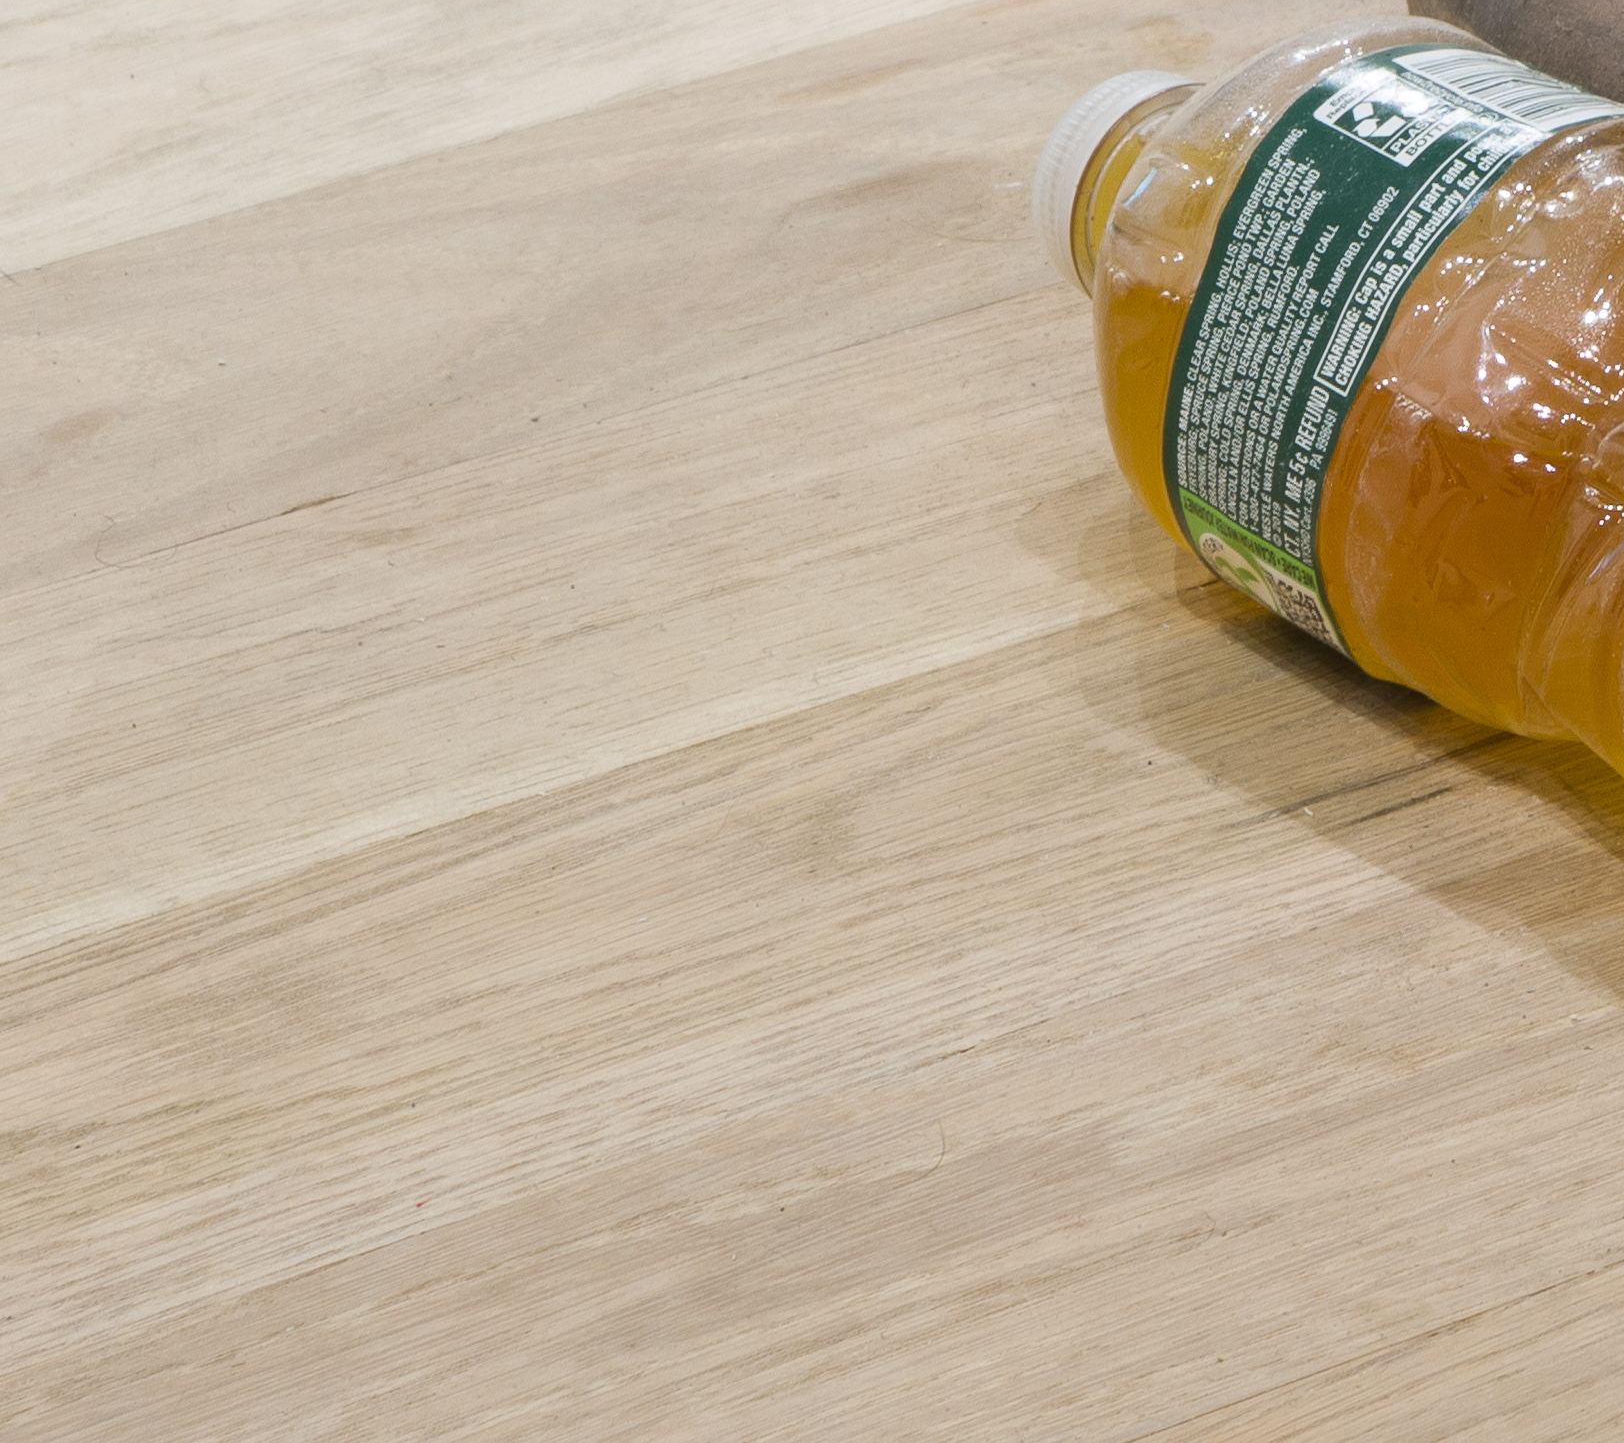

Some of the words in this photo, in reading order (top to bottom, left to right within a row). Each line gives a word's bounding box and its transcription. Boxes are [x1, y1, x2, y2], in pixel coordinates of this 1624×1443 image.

[1292, 185, 1325, 235] SPRING,
[1368, 183, 1399, 222] 06902
[1276, 233, 1298, 268] LUNA
[1315, 220, 1339, 254] CALL
[1357, 218, 1375, 239] CT
[1178, 383, 1194, 431] MAINE:
[1187, 339, 1206, 381] CLEAR
[1198, 289, 1224, 338] SPRING,
[1233, 167, 1274, 239] EVERGREEN
[1268, 123, 1305, 169] SPRING,
[1190, 374, 1208, 425] SPRUCE
[1200, 324, 1225, 374] SPRING,
[1217, 277, 1239, 323] PIERCE
[1232, 241, 1251, 277] POND
[1262, 156, 1295, 207] GARDEN
[1261, 268, 1283, 309] BELLA
[1291, 250, 1321, 302] REPORT
[1320, 238, 1363, 307] STAMFORD,
[1321, 304, 1362, 378] WARNING:
[1353, 275, 1379, 305] Cap
[1369, 259, 1387, 275] is
[1382, 247, 1396, 260] a
[1390, 208, 1423, 248] small
[1417, 179, 1443, 214] part
[1440, 157, 1466, 185] and
[1334, 320, 1372, 386] CHOKING
[1363, 260, 1408, 320] HAZARD,
[1400, 188, 1464, 265] particularly
[1456, 169, 1480, 191] for
[1207, 352, 1227, 393] WHITE
[1220, 309, 1241, 352] CEDAR
[1234, 259, 1260, 310] SPRING,
[1253, 209, 1281, 259] DALLAS
[1209, 390, 1229, 439] SPRING,
[1244, 265, 1271, 318] POLAND
[1263, 217, 1294, 266] SPRING,
[1286, 166, 1321, 217] POLAND
[1266, 263, 1299, 328] RUMFORD.
[1261, 286, 1319, 415] POLANDSPRING.COM
[1271, 300, 1299, 355] QUALITY
[1247, 329, 1274, 379] SPRING,
[1256, 354, 1277, 398] WATER
[1283, 337, 1314, 396] AMERICA
[1223, 376, 1244, 427] SPRING,
[1237, 378, 1256, 415] ELLIS
[1246, 409, 1260, 429] OR
[1252, 399, 1263, 411] A
[1269, 395, 1291, 439] NORTH
[1218, 428, 1232, 462] COLD
[1229, 416, 1246, 466] AND/OR
[1257, 415, 1271, 434] OR
[1284, 471, 1303, 503] ME
[1294, 383, 1331, 451] REFUND
[1238, 430, 1254, 501] QUESTIONS
[1261, 441, 1278, 492] WATERS
[1308, 452, 1323, 470] PA
